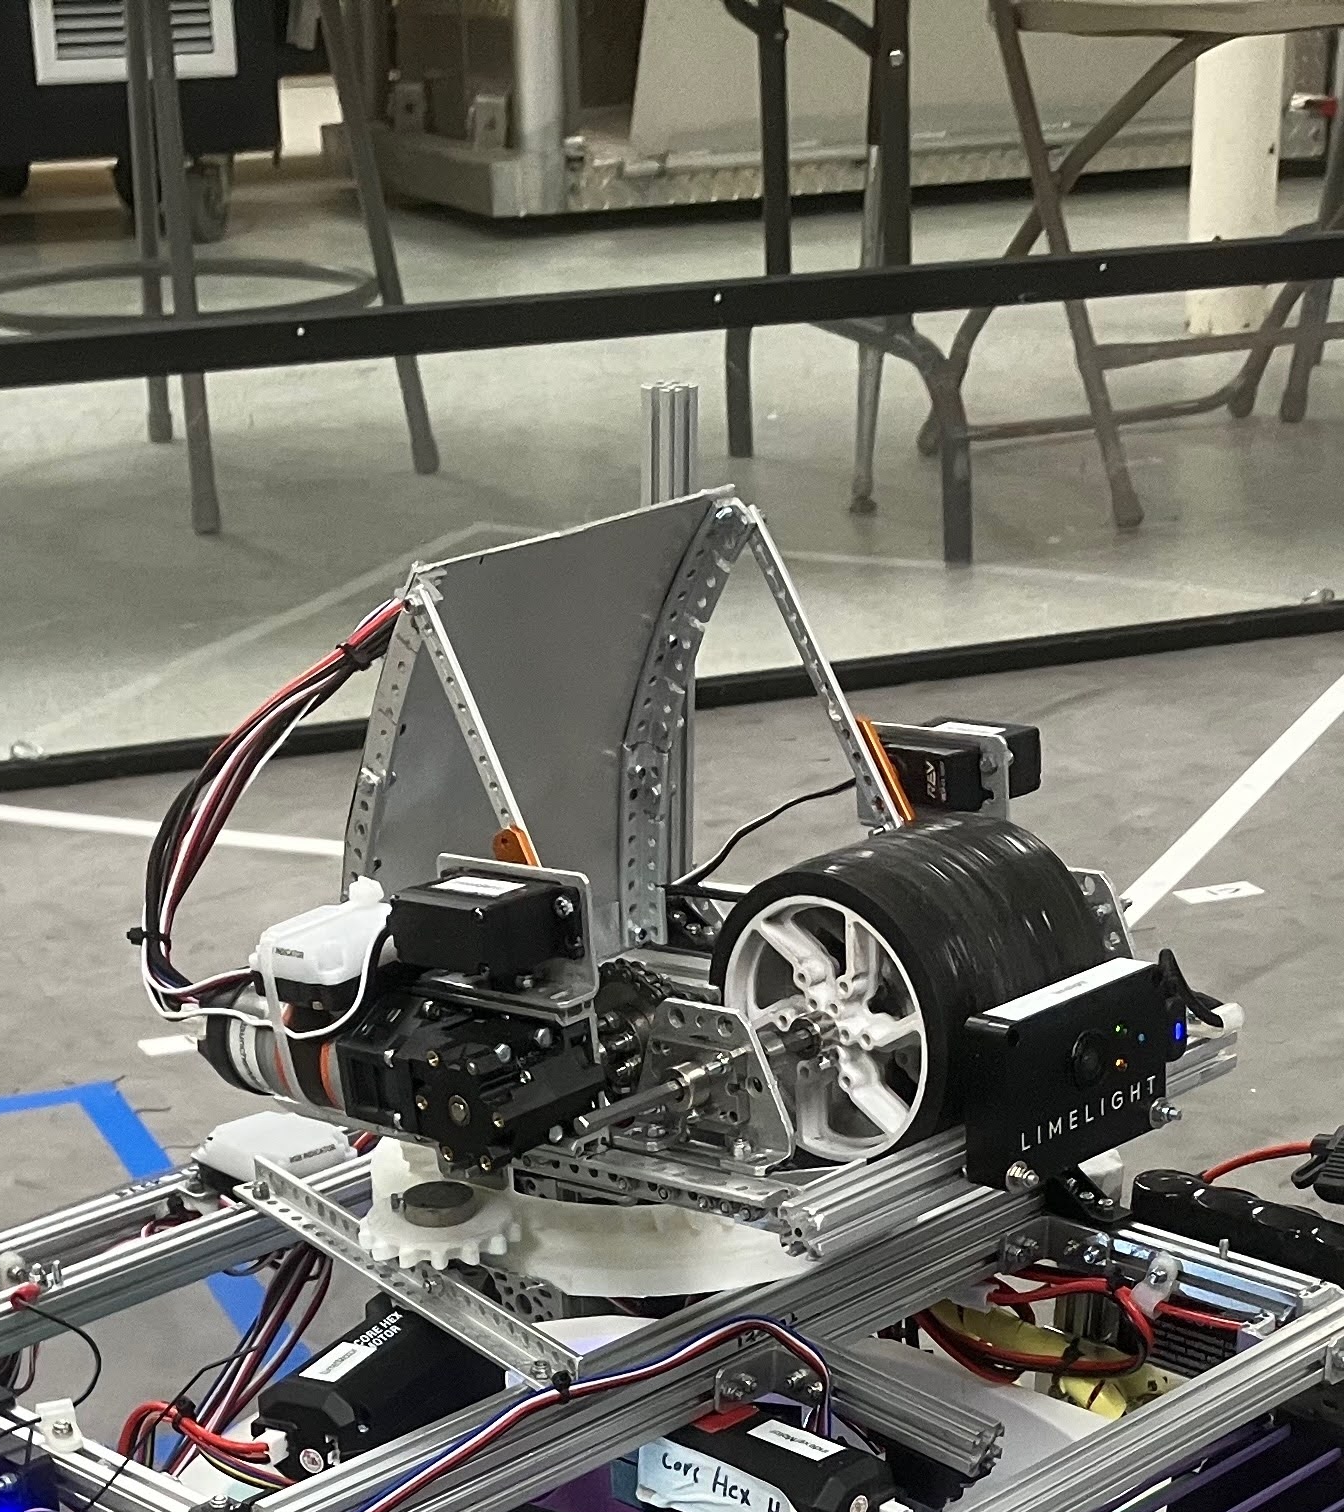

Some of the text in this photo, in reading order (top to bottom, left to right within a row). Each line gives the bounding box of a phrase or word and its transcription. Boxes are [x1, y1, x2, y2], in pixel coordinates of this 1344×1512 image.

[925, 760, 937, 799] REV
[1020, 1075, 1157, 1151] LIMELIGHT
[354, 1310, 404, 1345] CORE HEX
